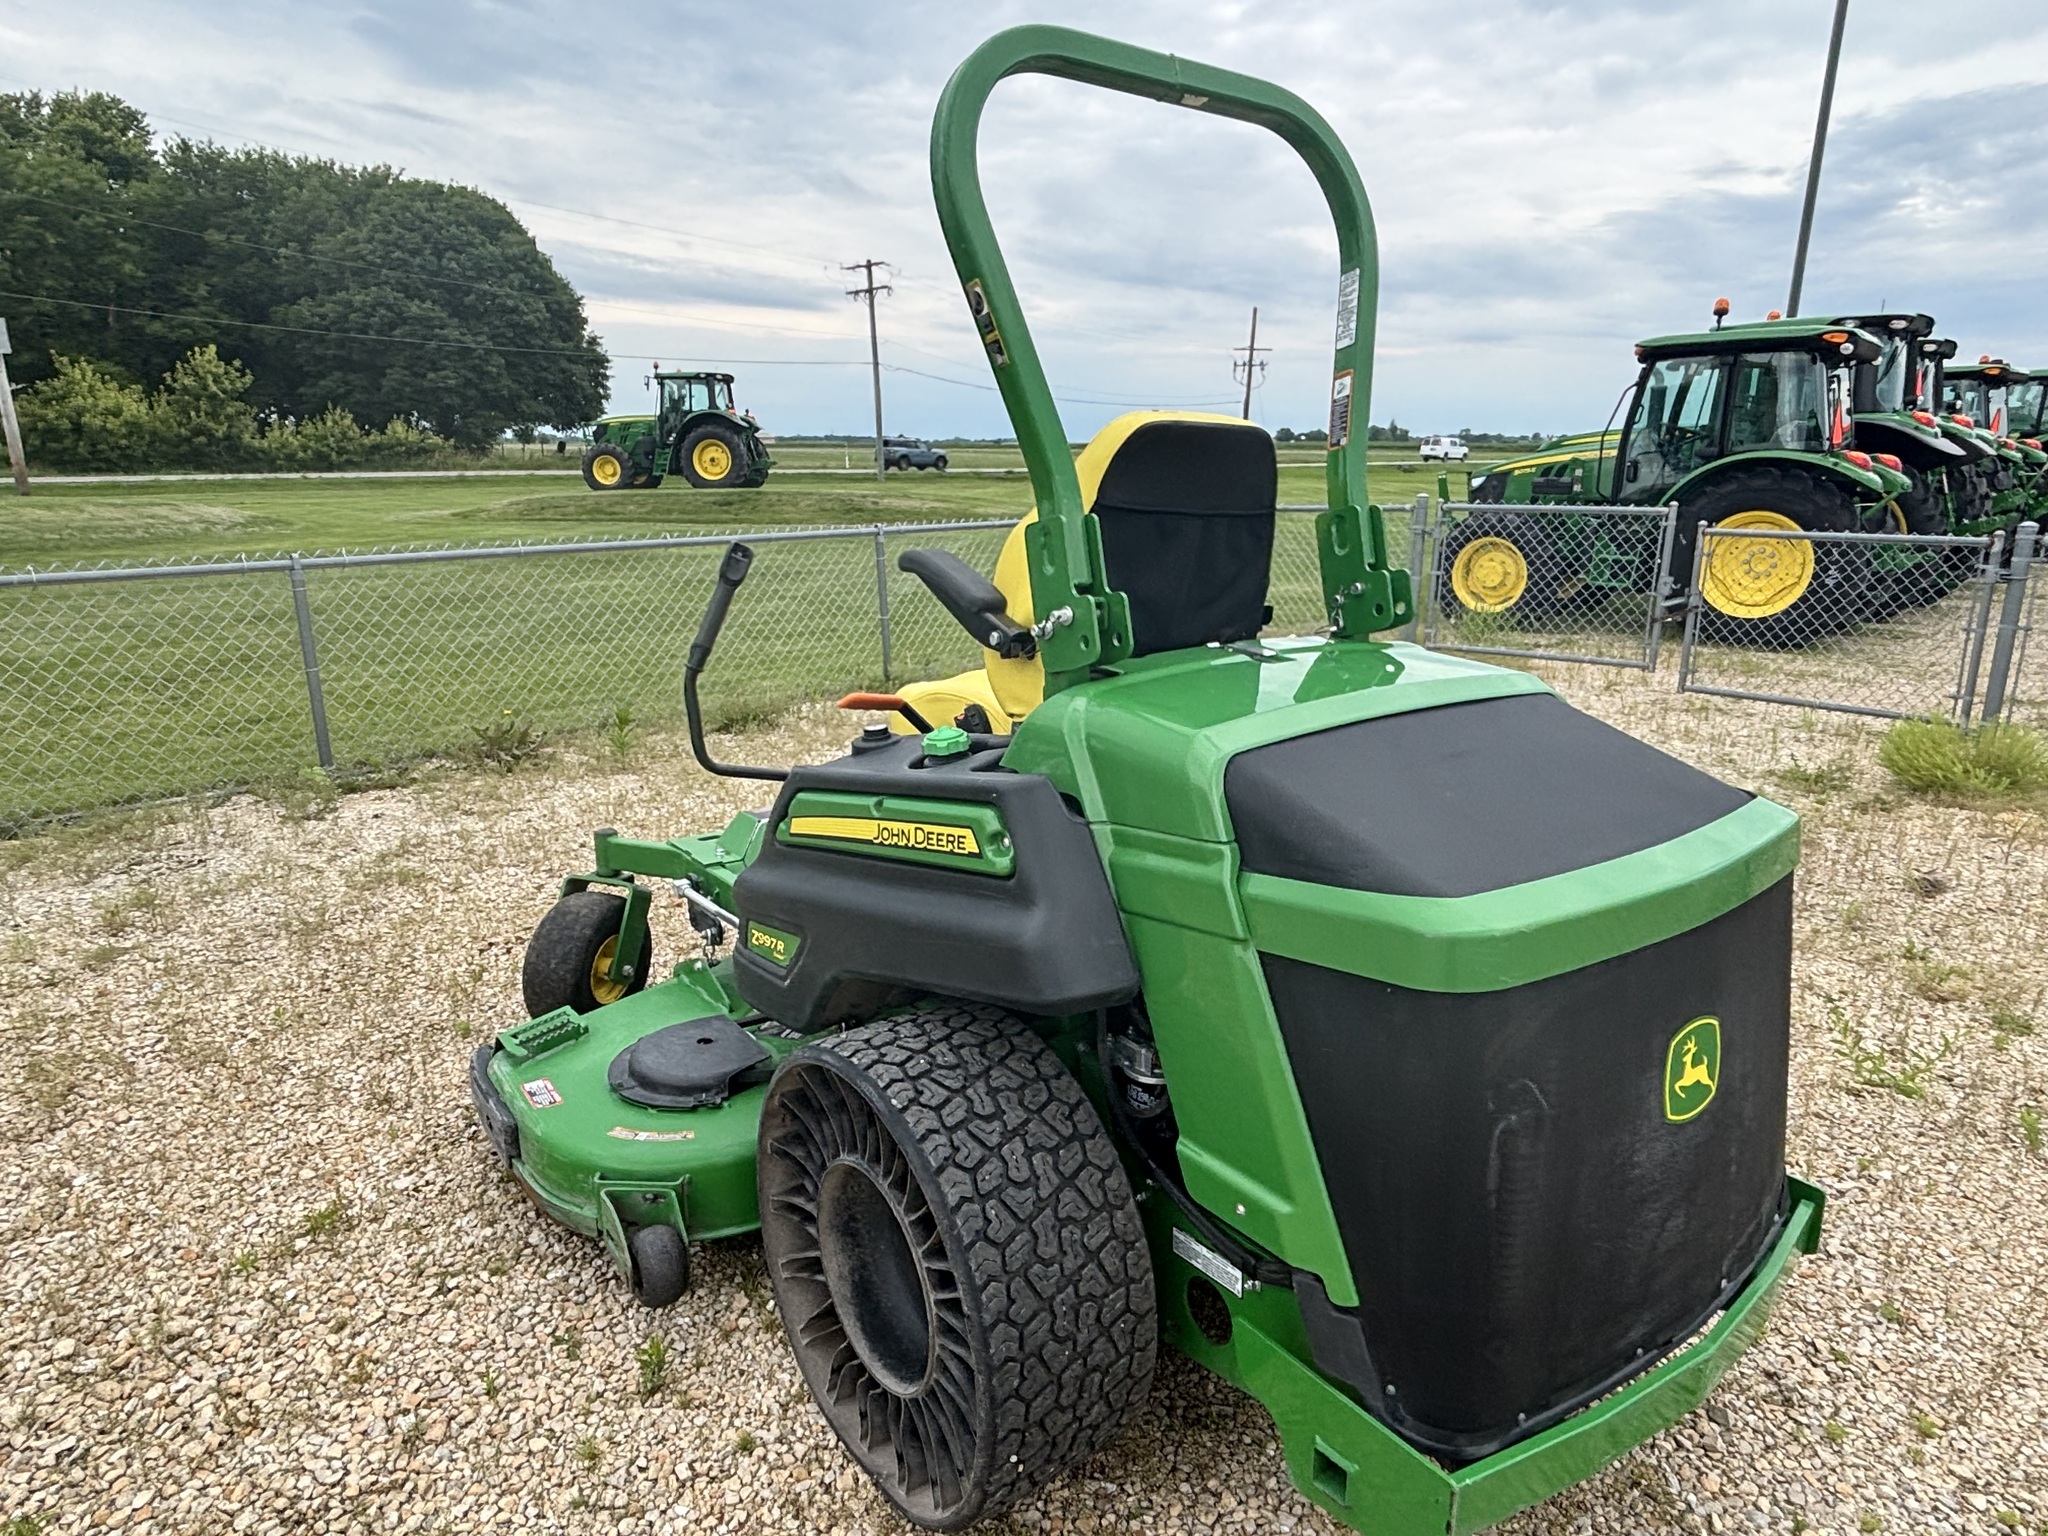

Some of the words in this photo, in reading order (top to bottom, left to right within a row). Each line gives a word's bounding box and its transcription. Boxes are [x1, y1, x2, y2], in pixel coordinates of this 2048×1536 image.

[872, 822, 911, 844] JOHN
[914, 826, 967, 851] DEERE
[751, 928, 785, 953] Z997R
